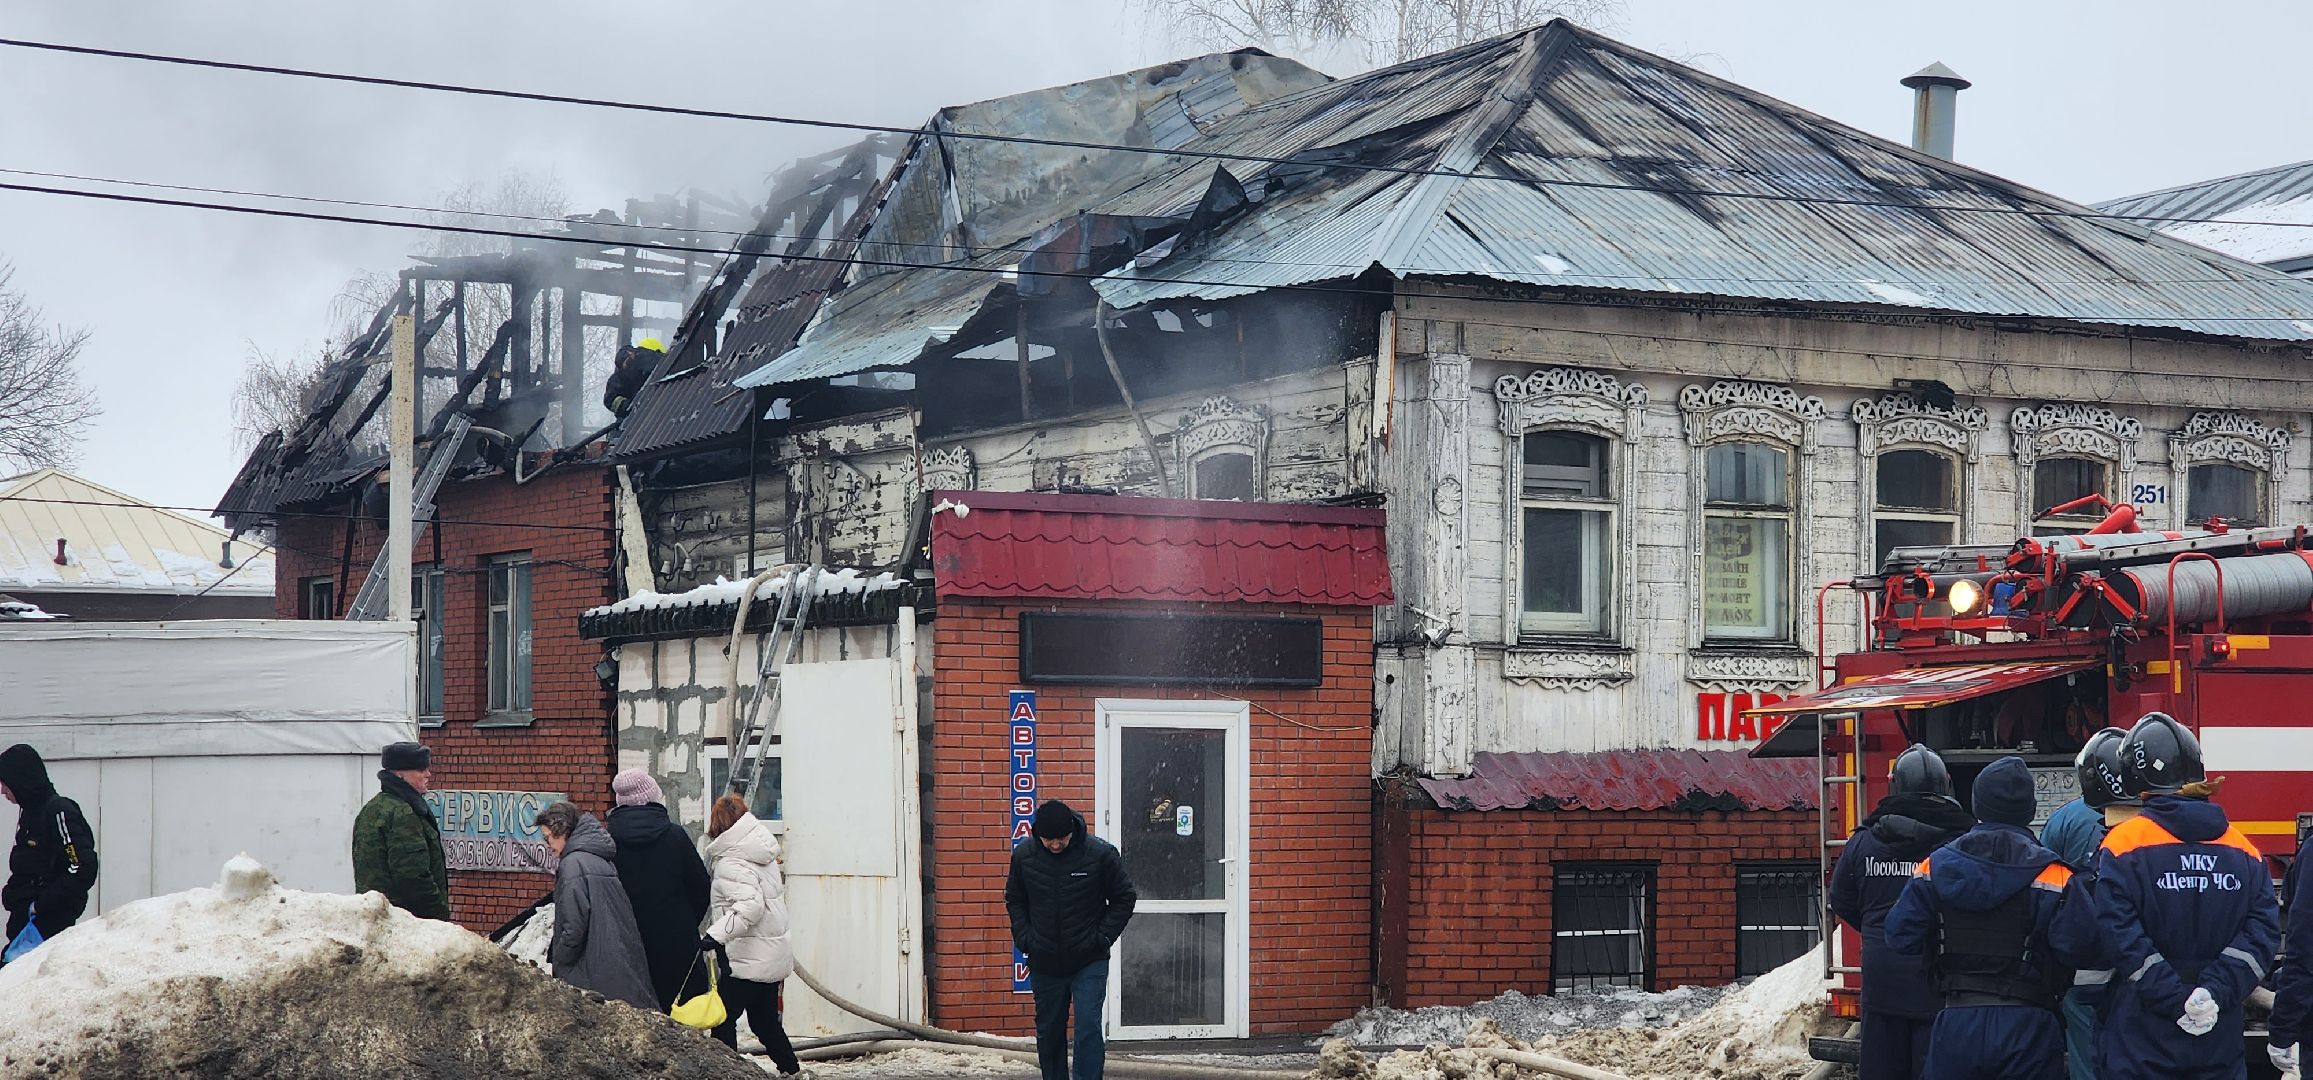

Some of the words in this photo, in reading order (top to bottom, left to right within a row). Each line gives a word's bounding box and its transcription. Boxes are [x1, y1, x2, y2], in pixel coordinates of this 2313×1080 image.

[2133, 484, 2165, 504] 251
[1698, 692, 1801, 741] ПАР
[2133, 740, 2147, 769] ПСО
[2098, 762, 2123, 794] ПСО
[1864, 856, 1921, 877] Мособлпо
[2180, 853, 2218, 872] МКУ
[2156, 871, 2209, 893] «Центр
[2211, 872, 2242, 891] ЧС»
